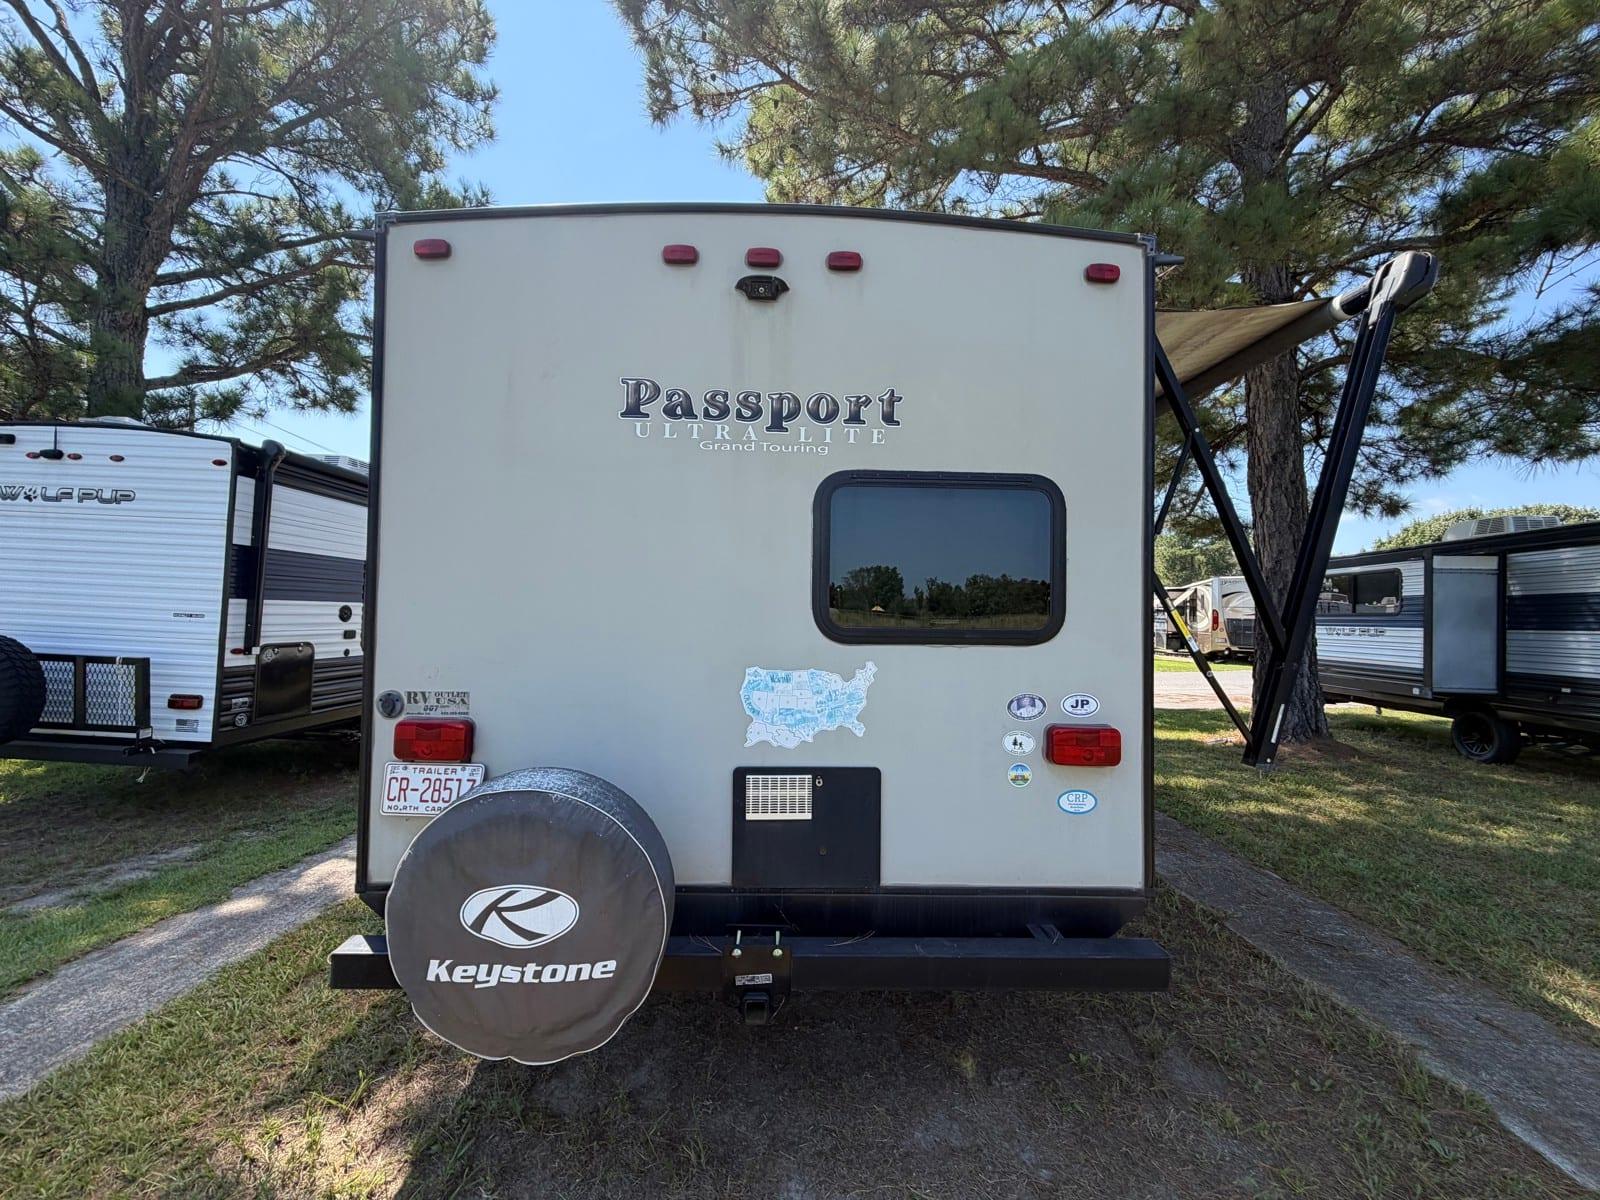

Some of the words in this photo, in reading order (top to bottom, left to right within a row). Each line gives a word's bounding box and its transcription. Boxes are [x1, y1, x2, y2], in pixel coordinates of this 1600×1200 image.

[619, 376, 904, 433] Passport
[635, 422, 758, 441] ULTRA
[799, 427, 886, 444] LITE
[700, 441, 755, 452] Grand
[760, 442, 829, 455] Touring
[78, 488, 136, 504] PUP
[406, 691, 432, 705] RV
[1070, 699, 1090, 709] JP
[412, 767, 457, 775] TRAILER
[425, 958, 617, 989] Keystone
